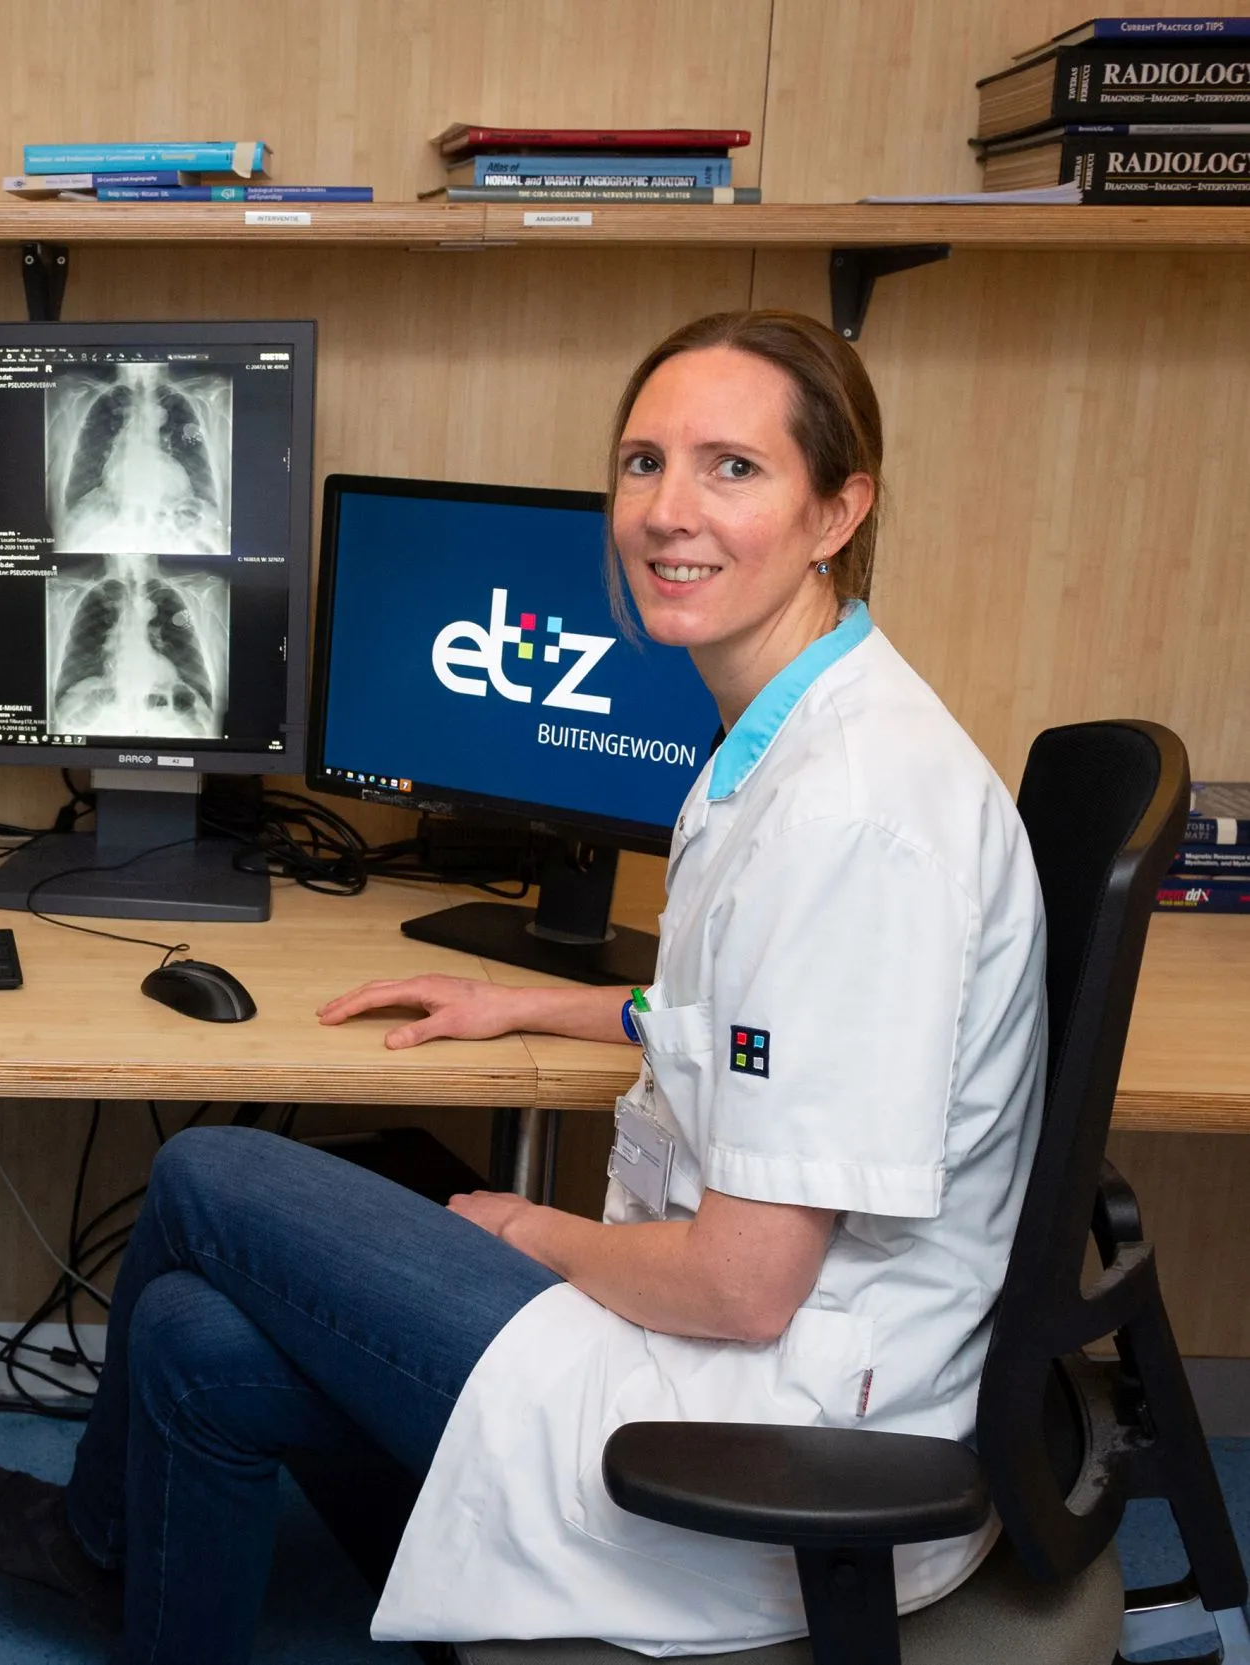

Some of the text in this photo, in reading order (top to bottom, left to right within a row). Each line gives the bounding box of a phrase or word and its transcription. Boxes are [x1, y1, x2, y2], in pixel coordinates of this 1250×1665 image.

[1121, 22, 1155, 31] CURRENT
[1156, 22, 1192, 31] PRACTICE
[1205, 22, 1224, 31] TIPS
[1068, 67, 1079, 100] TAVERAS
[1080, 64, 1091, 102] FERRUCCI
[1102, 63, 1250, 85] RADIOLOG
[487, 162, 520, 172] Atlas of
[1084, 153, 1095, 191] FERRUCCI
[1106, 152, 1250, 173] RADIOLOG
[485, 175, 695, 187] NORMAL and VARIANT ANGIOGRAPHIC ANATOMY
[45, 365, 53, 373] R
[432, 588, 617, 715] etz
[538, 723, 696, 767] BUITENGEWOON
[119, 754, 152, 764] BARCO
